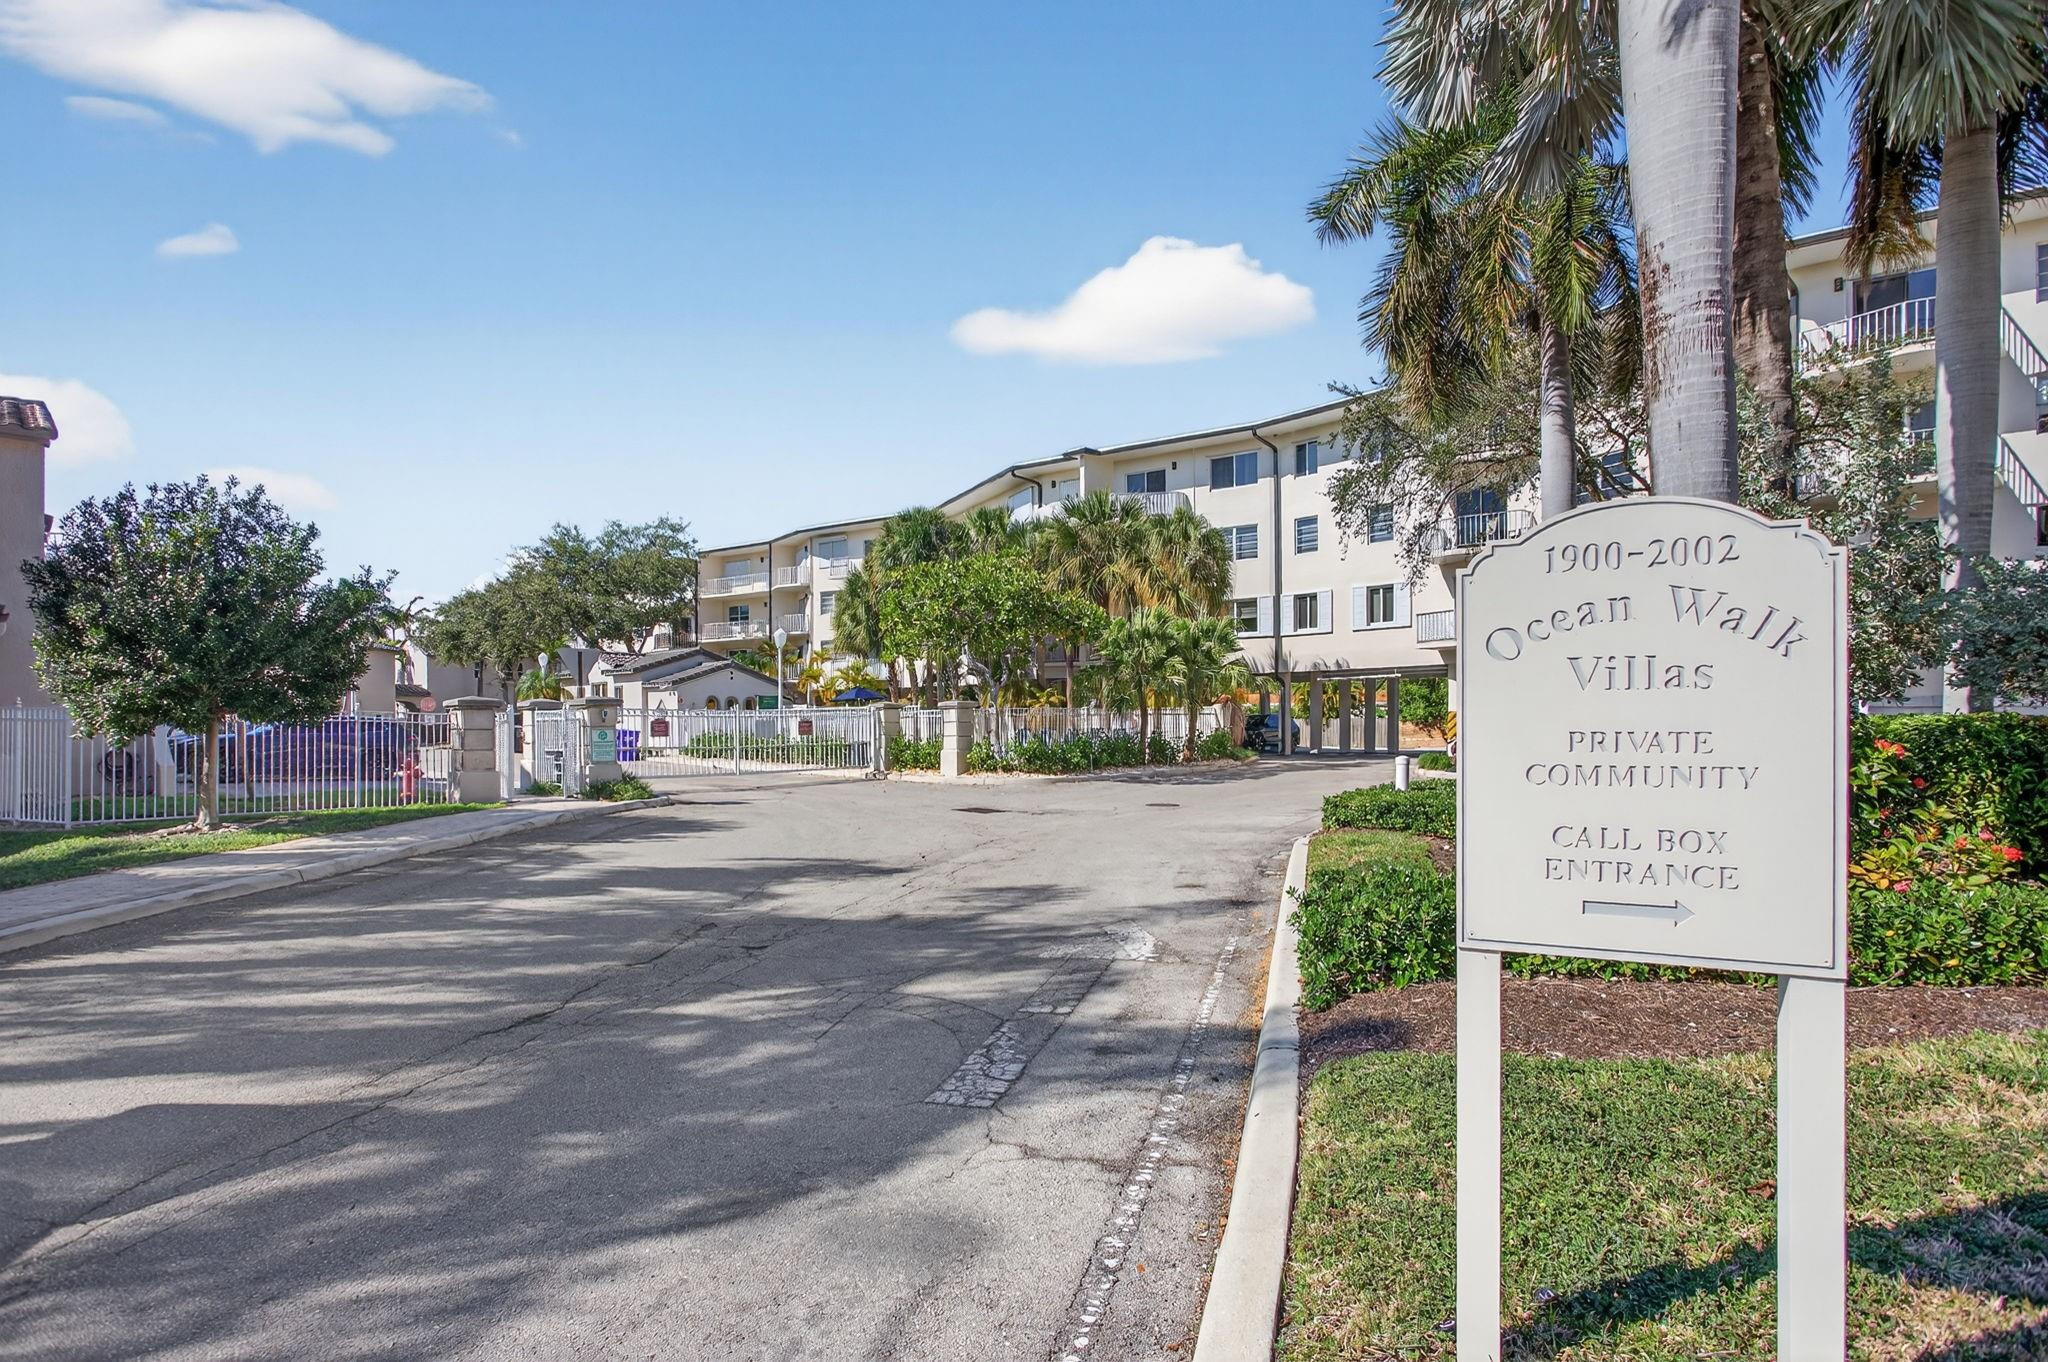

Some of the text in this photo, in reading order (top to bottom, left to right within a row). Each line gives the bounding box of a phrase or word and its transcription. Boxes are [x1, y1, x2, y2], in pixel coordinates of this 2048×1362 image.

[1545, 535, 1740, 573] 1900-2002
[1486, 584, 1808, 661] Ocean Walk
[1567, 655, 1714, 691] Villas
[1568, 731, 1714, 754] PRIVATE
[1525, 763, 1760, 789] COMMUNITY
[1552, 826, 1728, 854] CALL BOX
[1545, 858, 1739, 889] ENTRANCE
